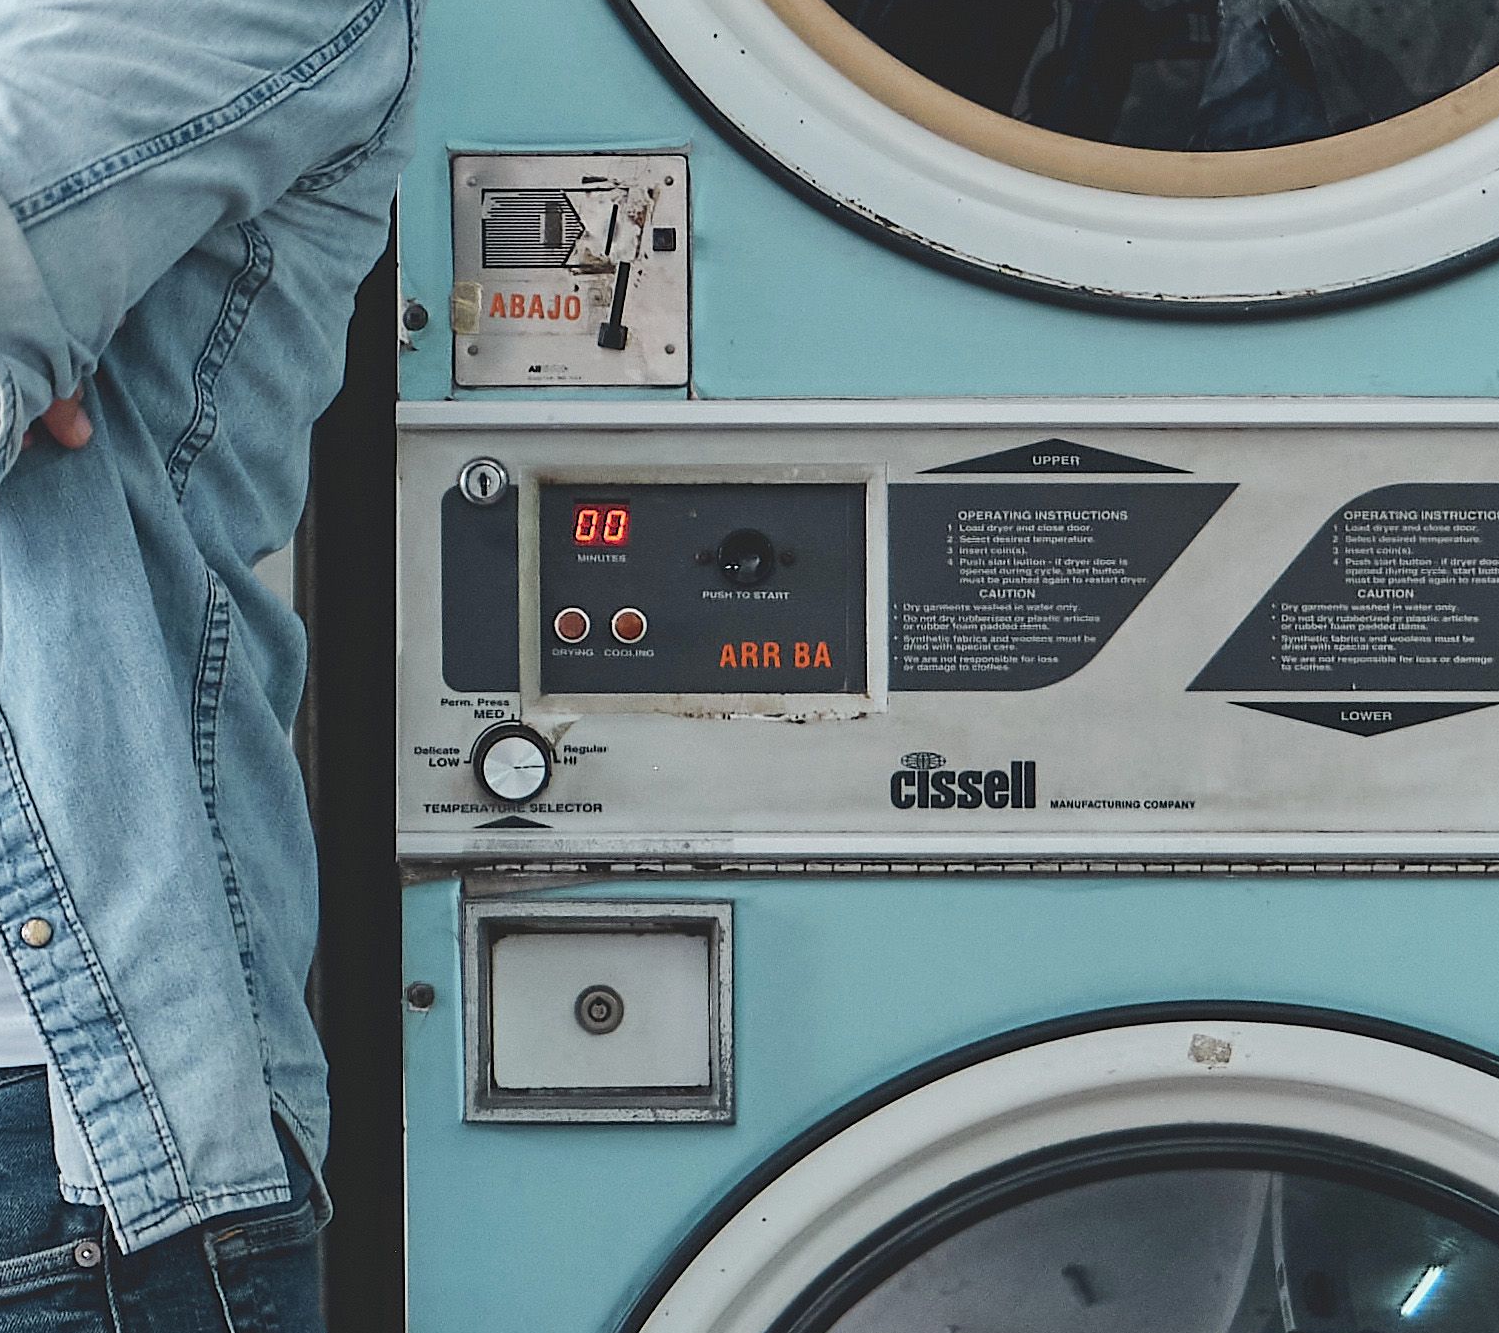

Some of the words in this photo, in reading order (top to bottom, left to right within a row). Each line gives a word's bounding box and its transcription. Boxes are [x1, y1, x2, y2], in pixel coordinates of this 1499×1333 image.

[489, 293, 581, 320] ABAJO
[1032, 455, 1081, 466] UPPER
[958, 511, 1031, 520] OPERATING
[1035, 511, 1128, 520] INSTRUCTIONS
[1344, 511, 1417, 520] OPERATING
[575, 510, 627, 542] 00
[578, 554, 626, 562] MINUTES
[702, 591, 732, 599] PUSH
[736, 591, 750, 599] TO
[754, 591, 790, 599] START
[980, 589, 1035, 598] CAUTION
[1358, 589, 1414, 599] CAUTION
[440, 698, 474, 707] Perm.
[478, 698, 509, 707] Press
[474, 709, 505, 718] MED
[1341, 711, 1392, 721] LOWER
[414, 746, 459, 755] Delicate
[564, 745, 608, 755] Regular
[429, 757, 459, 766] LOW
[564, 757, 577, 765] HI
[423, 804, 526, 813] TEMPERATURE
[530, 804, 603, 813] SELECTOR
[1050, 800, 1140, 808] MANUFACTURING
[1144, 800, 1195, 808] COMPANY
